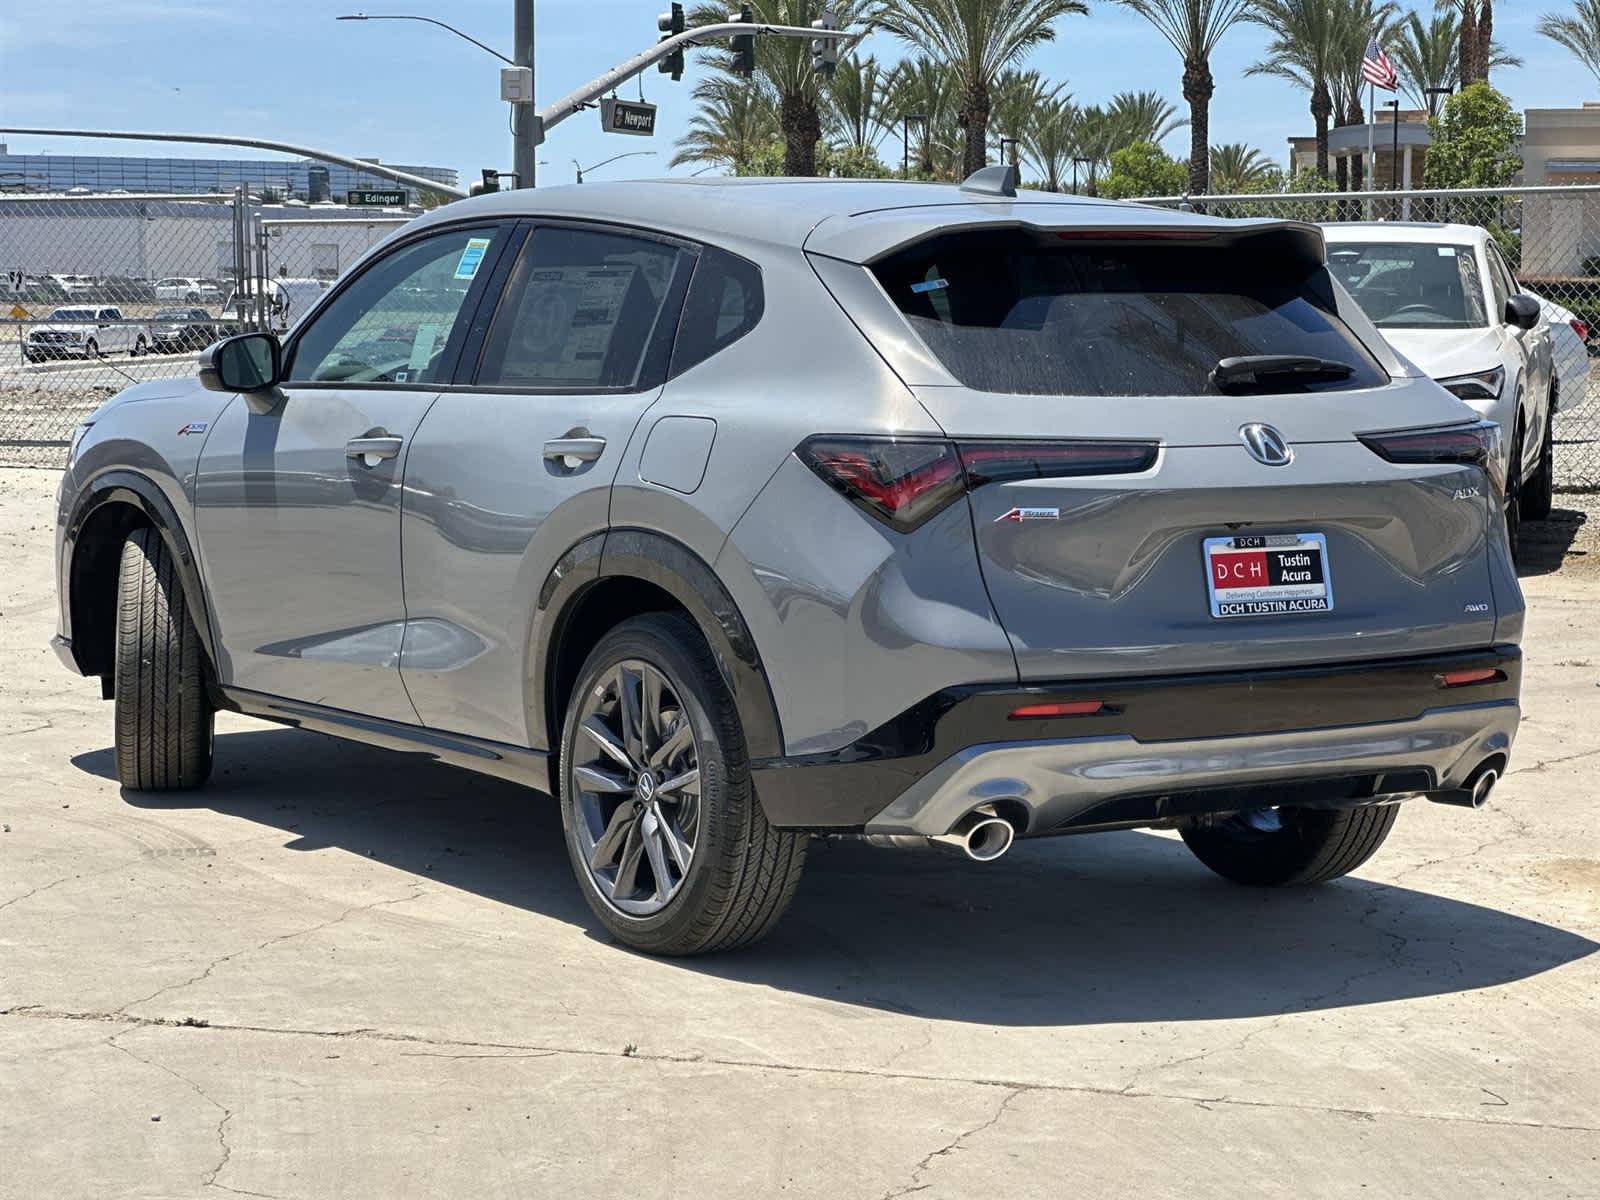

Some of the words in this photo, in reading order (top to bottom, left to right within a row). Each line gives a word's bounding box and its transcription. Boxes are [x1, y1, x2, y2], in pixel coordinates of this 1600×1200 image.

[624, 111, 652, 129] Newport
[365, 193, 399, 206] Edinger
[1240, 538, 1261, 547] DCH
[1278, 553, 1311, 567] Tustin
[1217, 562, 1262, 579] DCH
[1281, 570, 1312, 582] Acura
[1220, 604, 1245, 615] DCH
[1246, 601, 1287, 613] TUSTIN
[1289, 599, 1327, 611] ACURA
